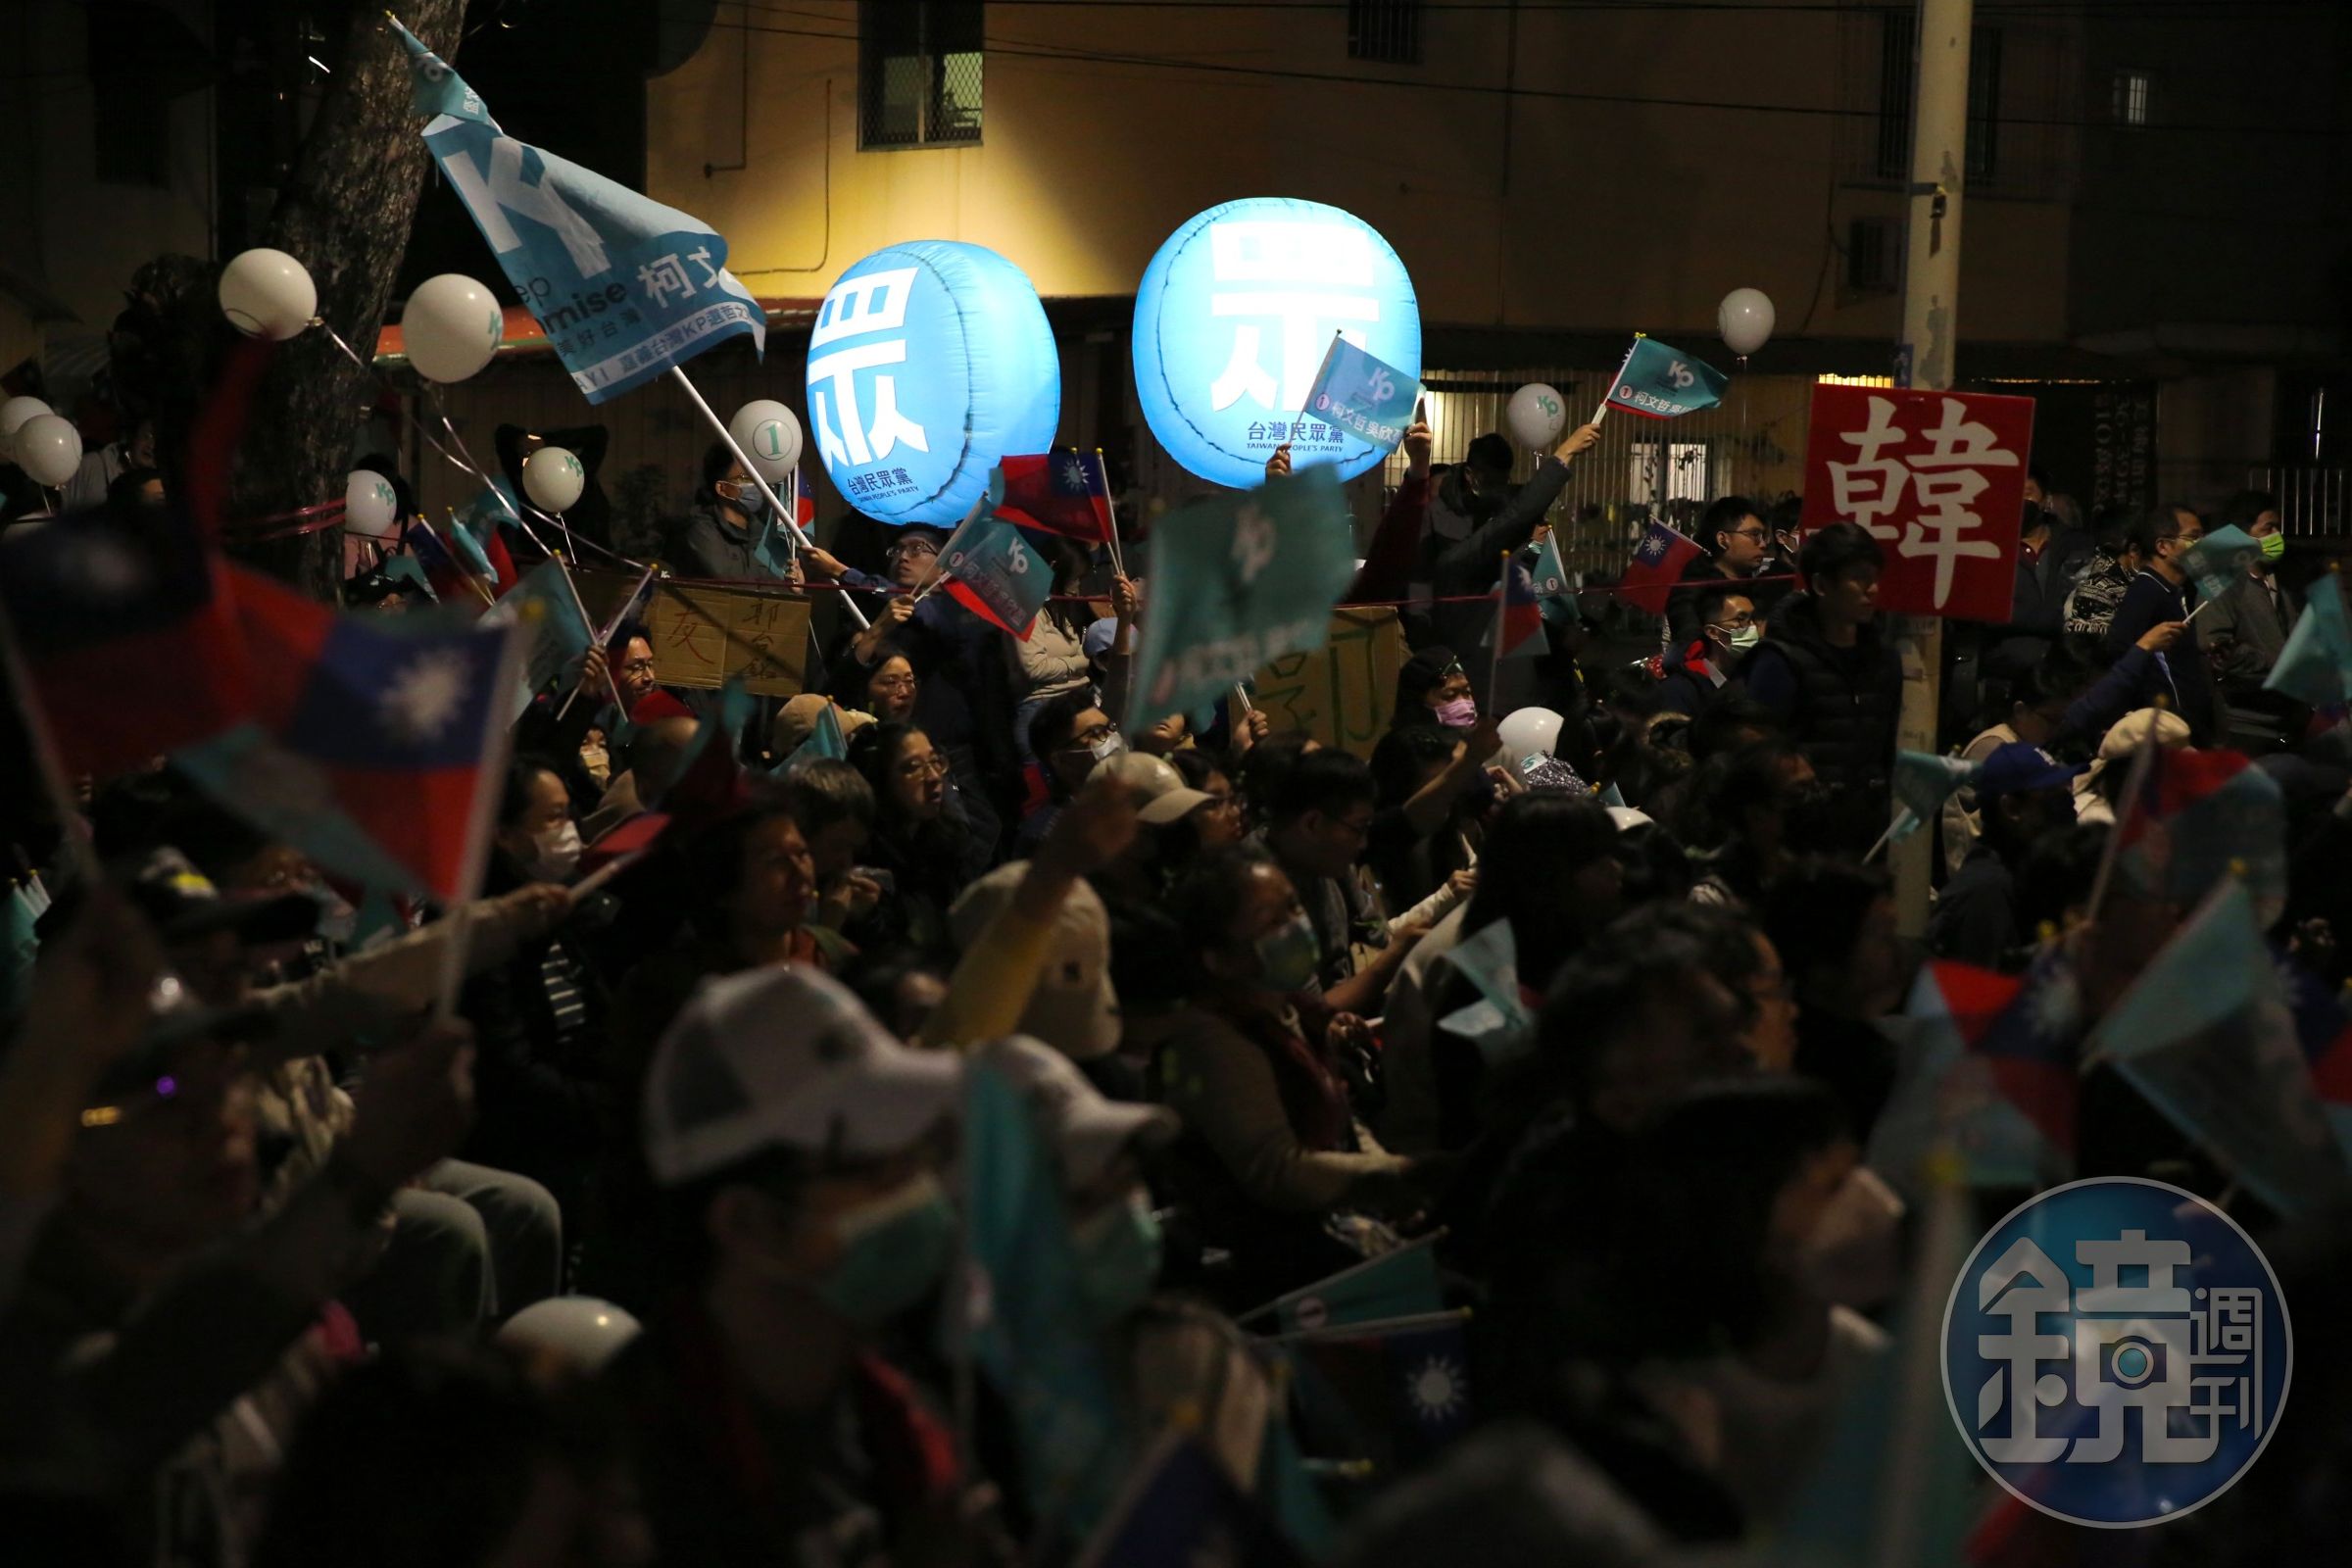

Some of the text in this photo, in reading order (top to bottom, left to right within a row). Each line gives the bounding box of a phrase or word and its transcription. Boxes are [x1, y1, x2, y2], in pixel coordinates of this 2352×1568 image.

[808, 267, 930, 476] 眾
[1210, 221, 1380, 413] 眾
[847, 466, 913, 496] 台灣民眾黨
[1248, 420, 1345, 444] 台灣民眾黨
[1805, 395, 2021, 610] 韓
